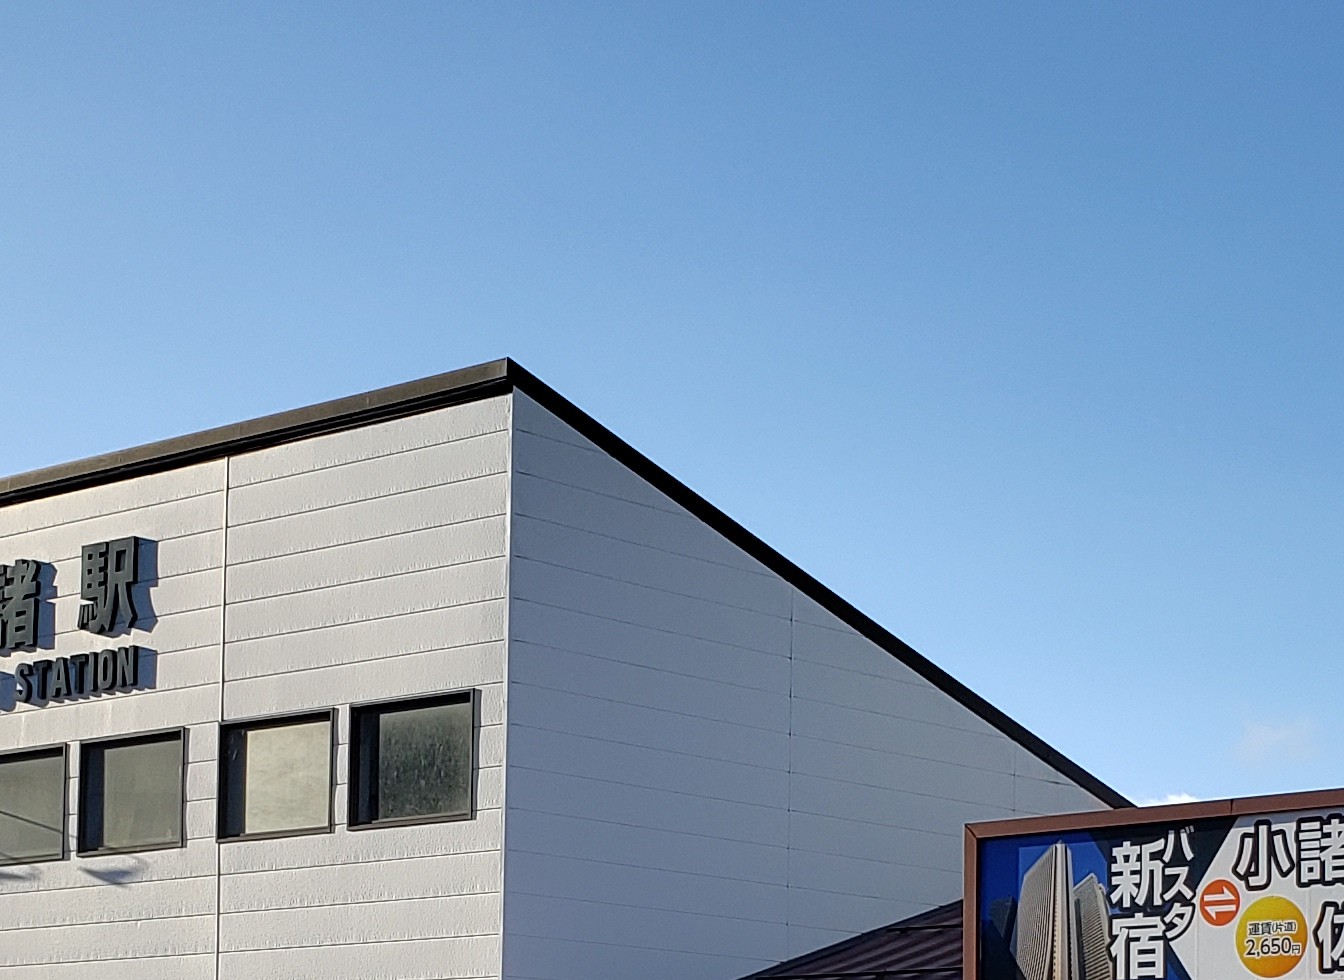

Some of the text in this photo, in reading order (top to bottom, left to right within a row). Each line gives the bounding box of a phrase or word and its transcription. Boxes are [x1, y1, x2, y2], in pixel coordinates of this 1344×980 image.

[14, 645, 139, 703] STATION
[1109, 838, 1167, 980] 新宿
[1161, 825, 1196, 940] バスタ
[1244, 936, 1302, 959] 2,650円
